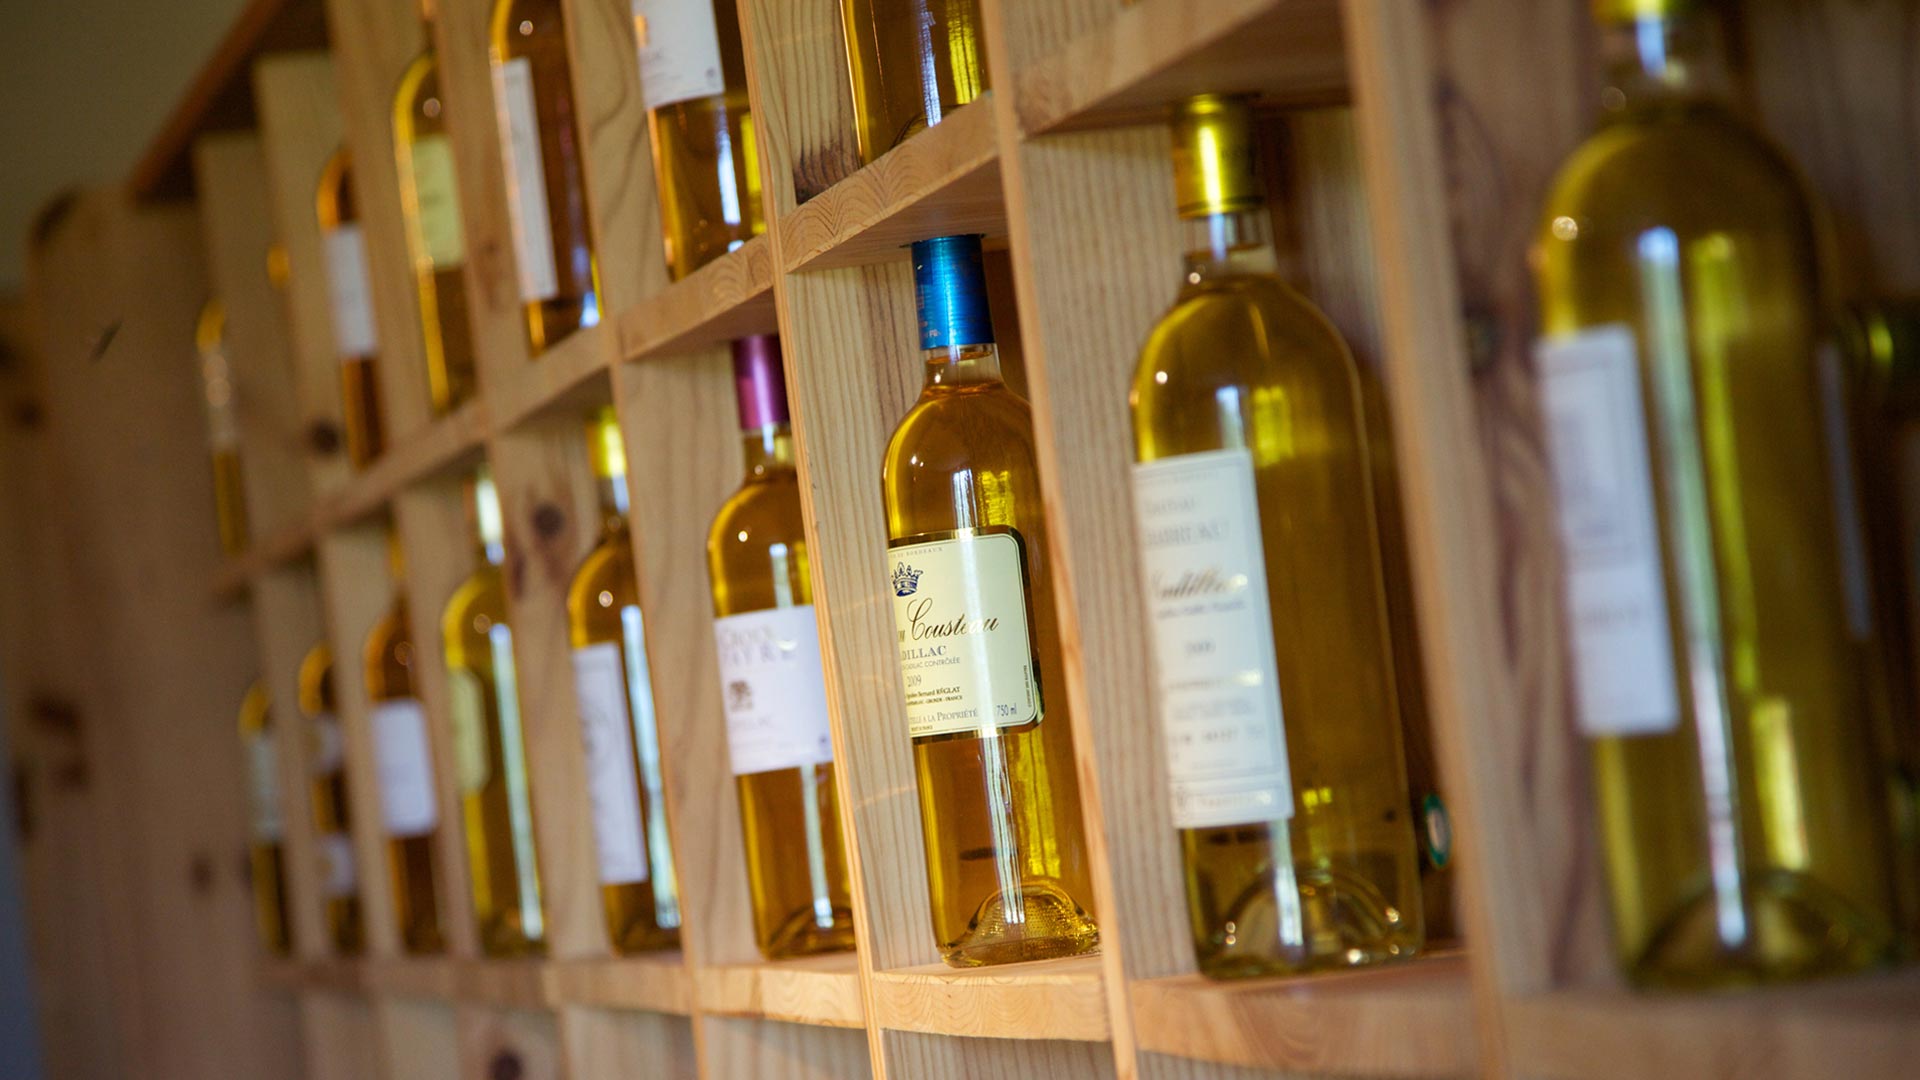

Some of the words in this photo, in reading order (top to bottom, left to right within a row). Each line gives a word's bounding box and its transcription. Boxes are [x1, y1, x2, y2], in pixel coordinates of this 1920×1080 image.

[906, 547, 943, 556] BORDEAUX
[902, 645, 947, 661] DILLAC
[937, 708, 978, 721] PROPRIÉTÉ
[996, 704, 1009, 716] 750
[1010, 702, 1017, 714] ml
